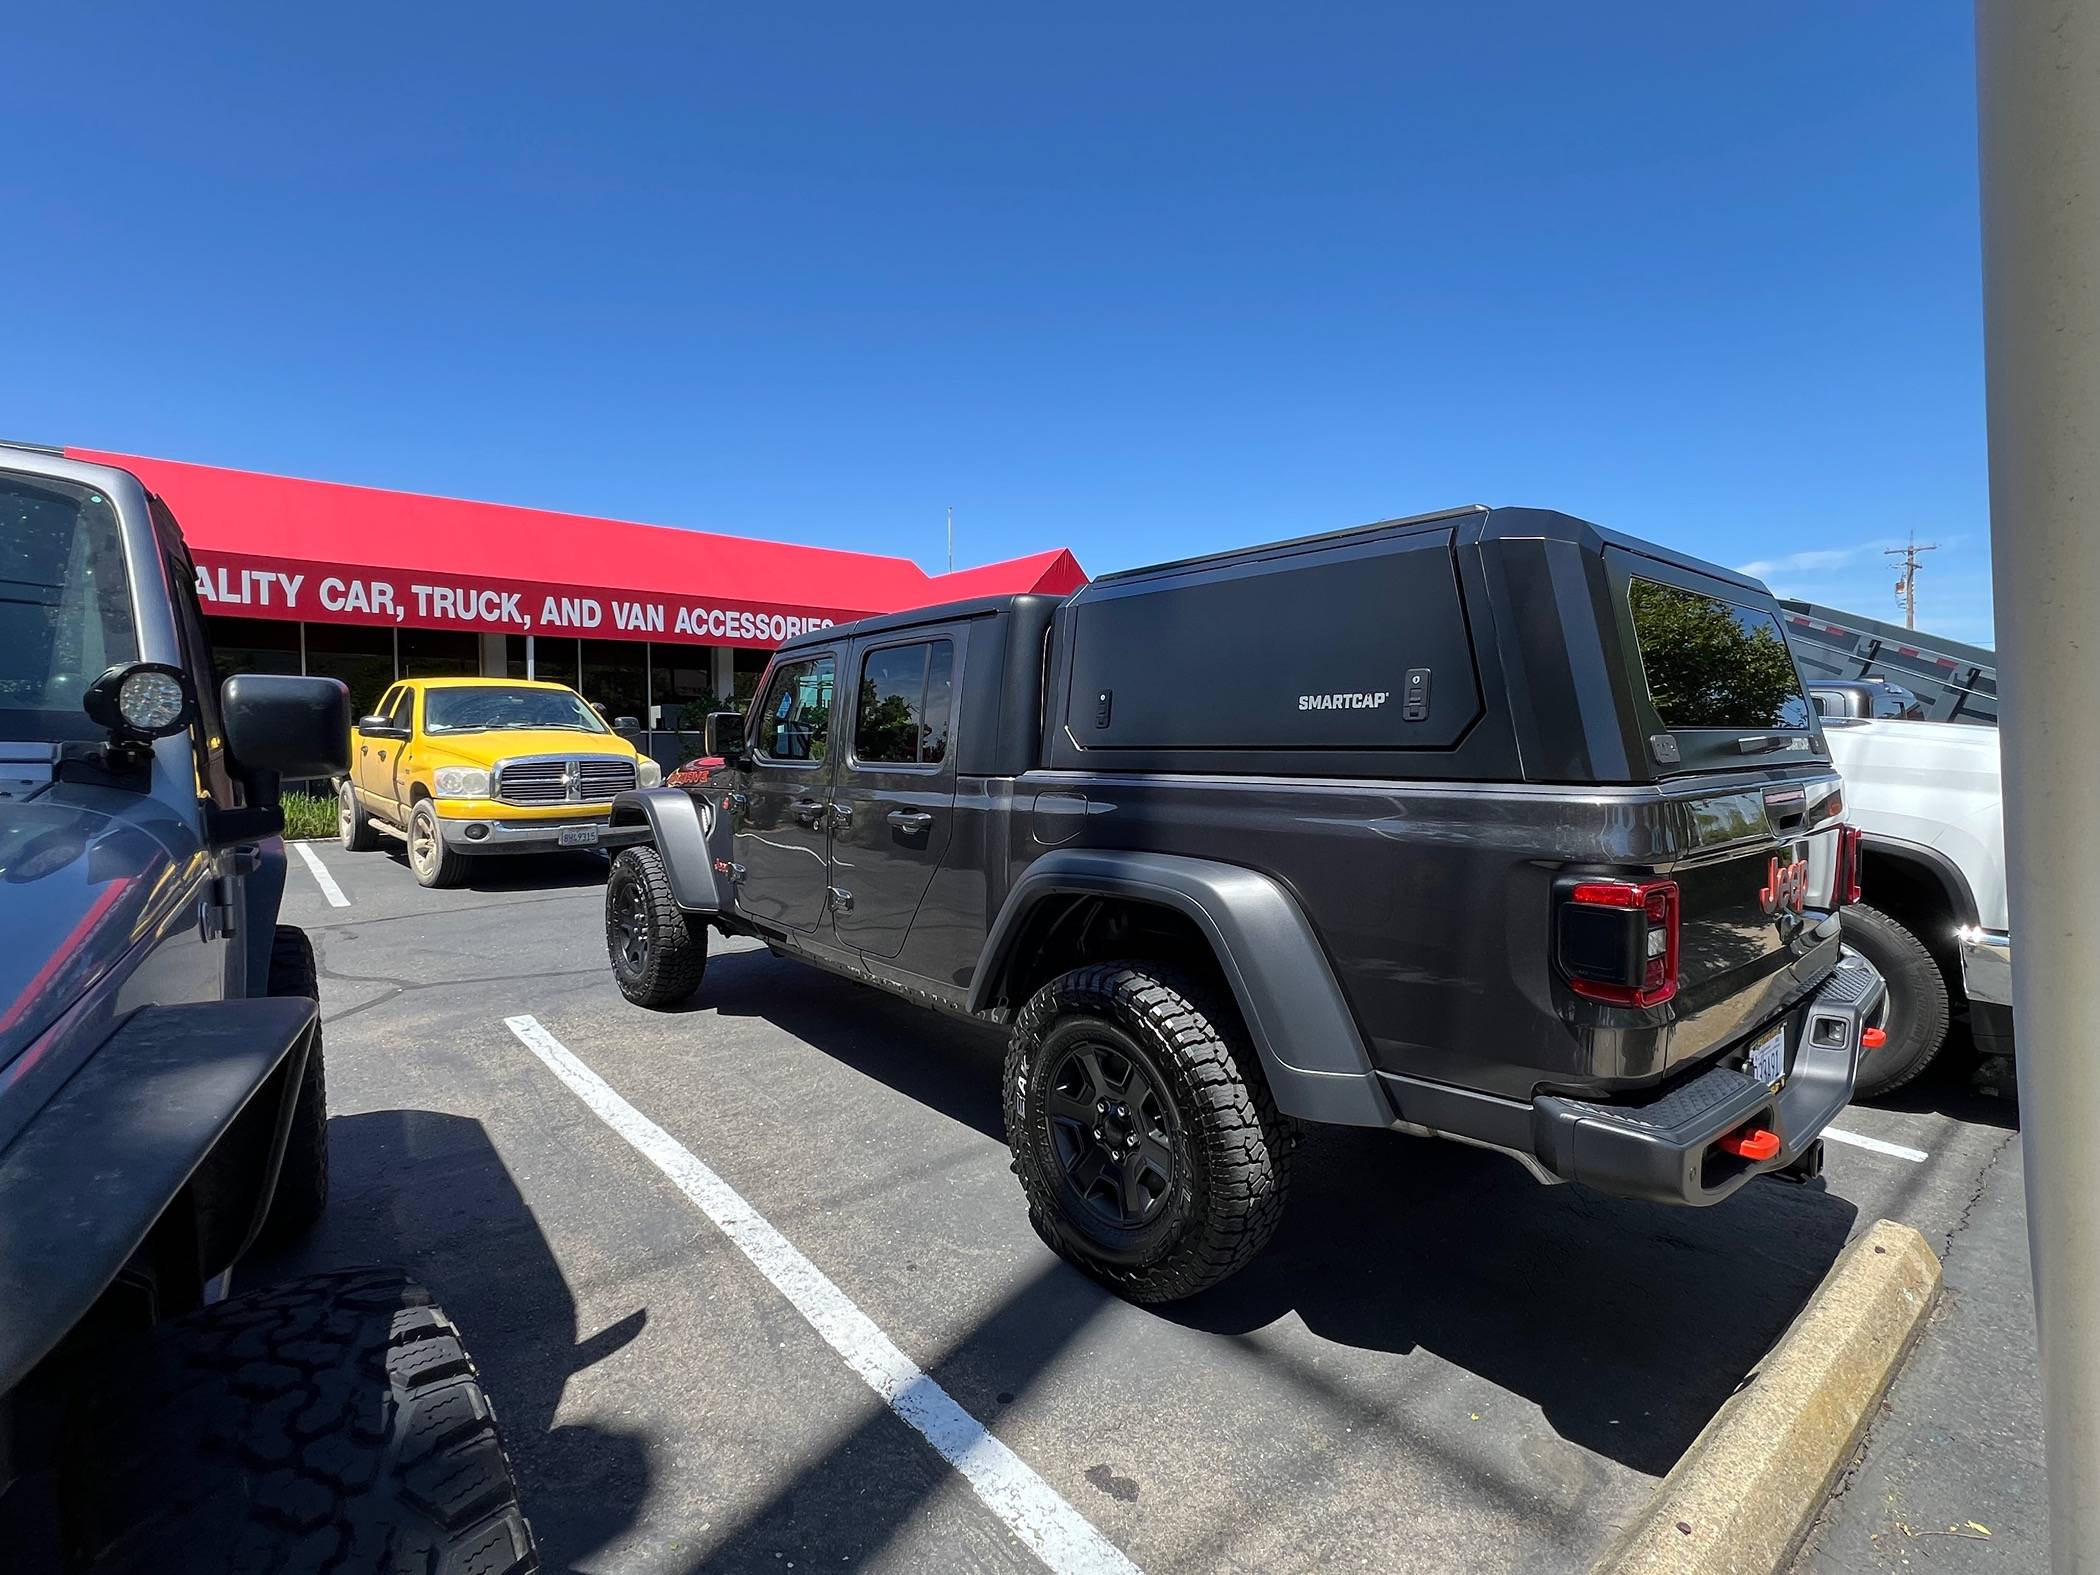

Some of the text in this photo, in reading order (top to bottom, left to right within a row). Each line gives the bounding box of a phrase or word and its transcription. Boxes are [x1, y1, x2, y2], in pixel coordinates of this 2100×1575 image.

[319, 577, 405, 622] CAR,
[411, 585, 531, 631] TRUCK,
[540, 596, 602, 628] AND
[611, 601, 665, 632] VAN
[1299, 693, 1388, 711] SMARTCAP
[1759, 856, 1808, 915] Jeep
